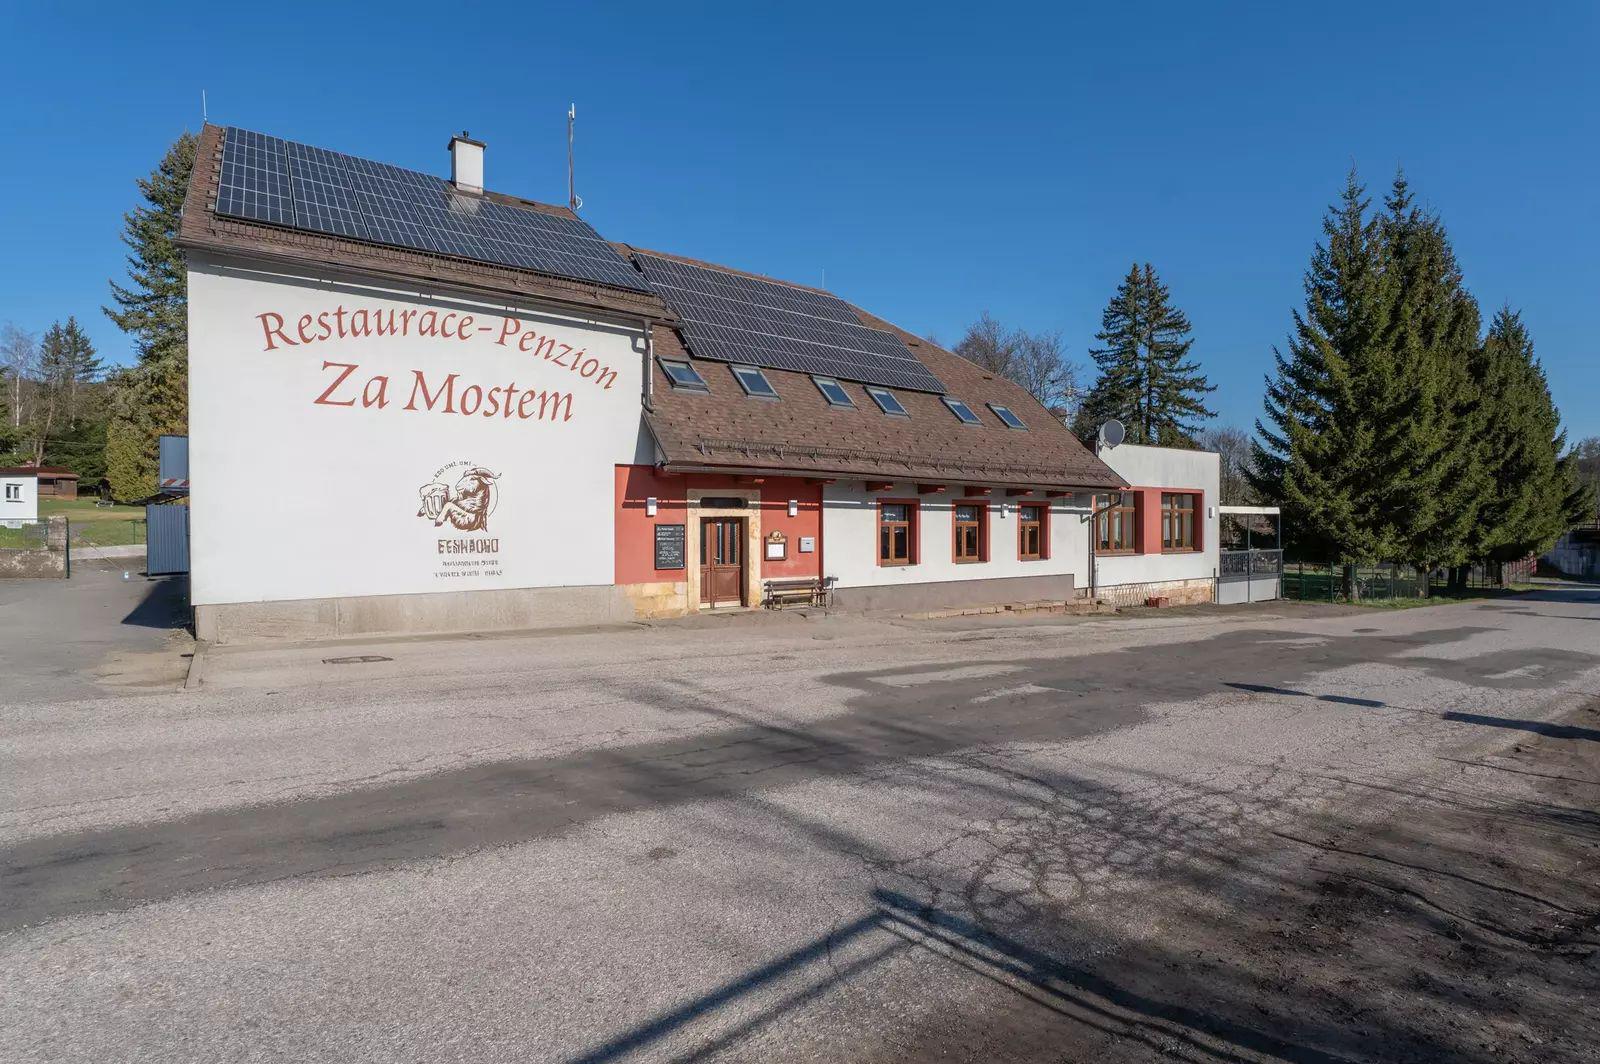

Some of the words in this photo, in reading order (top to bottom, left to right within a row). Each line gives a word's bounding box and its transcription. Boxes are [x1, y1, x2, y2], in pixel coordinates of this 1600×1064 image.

[255, 304, 619, 390] Restaurace-Penzion
[313, 360, 390, 409] Za
[402, 369, 575, 423] Mostem
